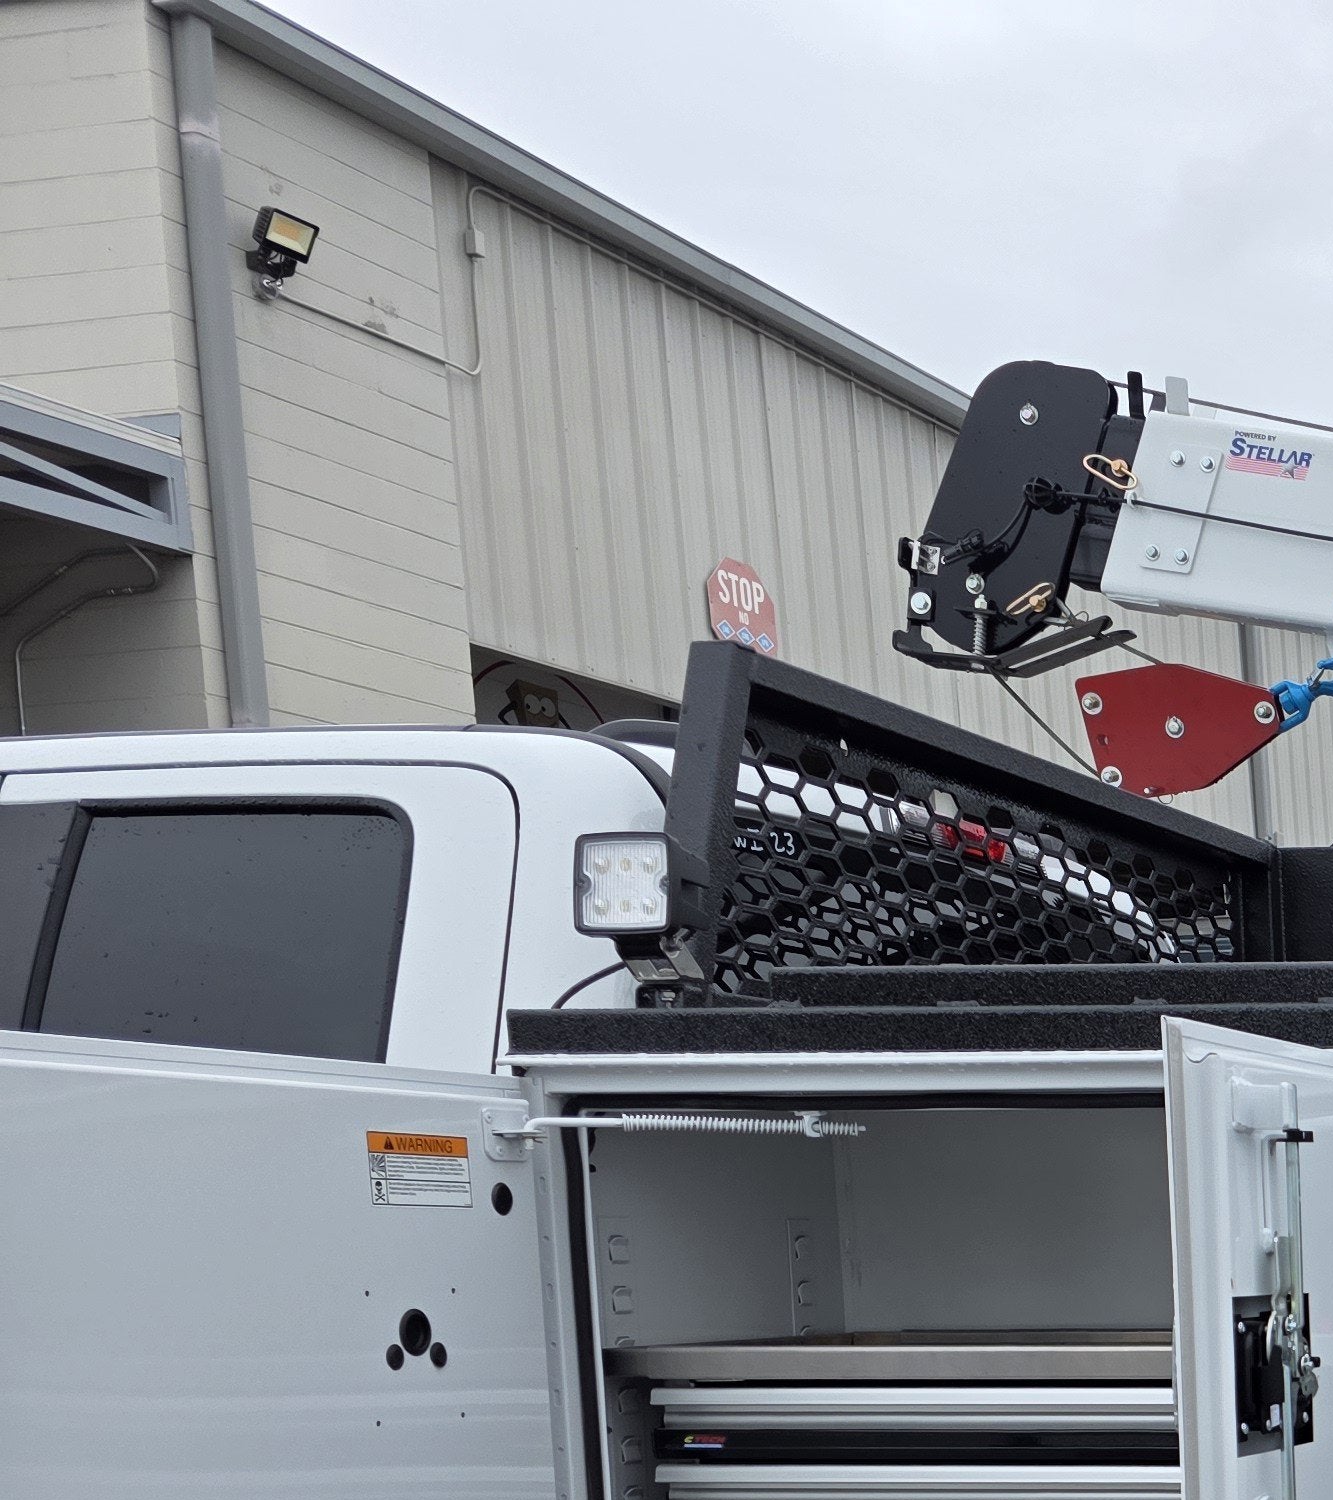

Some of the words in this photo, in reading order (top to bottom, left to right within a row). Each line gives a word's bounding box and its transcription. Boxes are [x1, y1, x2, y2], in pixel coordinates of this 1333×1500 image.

[1234, 430, 1266, 440] POWERED
[1267, 434, 1276, 442] BY
[1229, 437, 1313, 468] STELLAR
[717, 569, 765, 615] STOP
[738, 611, 750, 625] NO
[395, 1137, 453, 1154] WARNING
